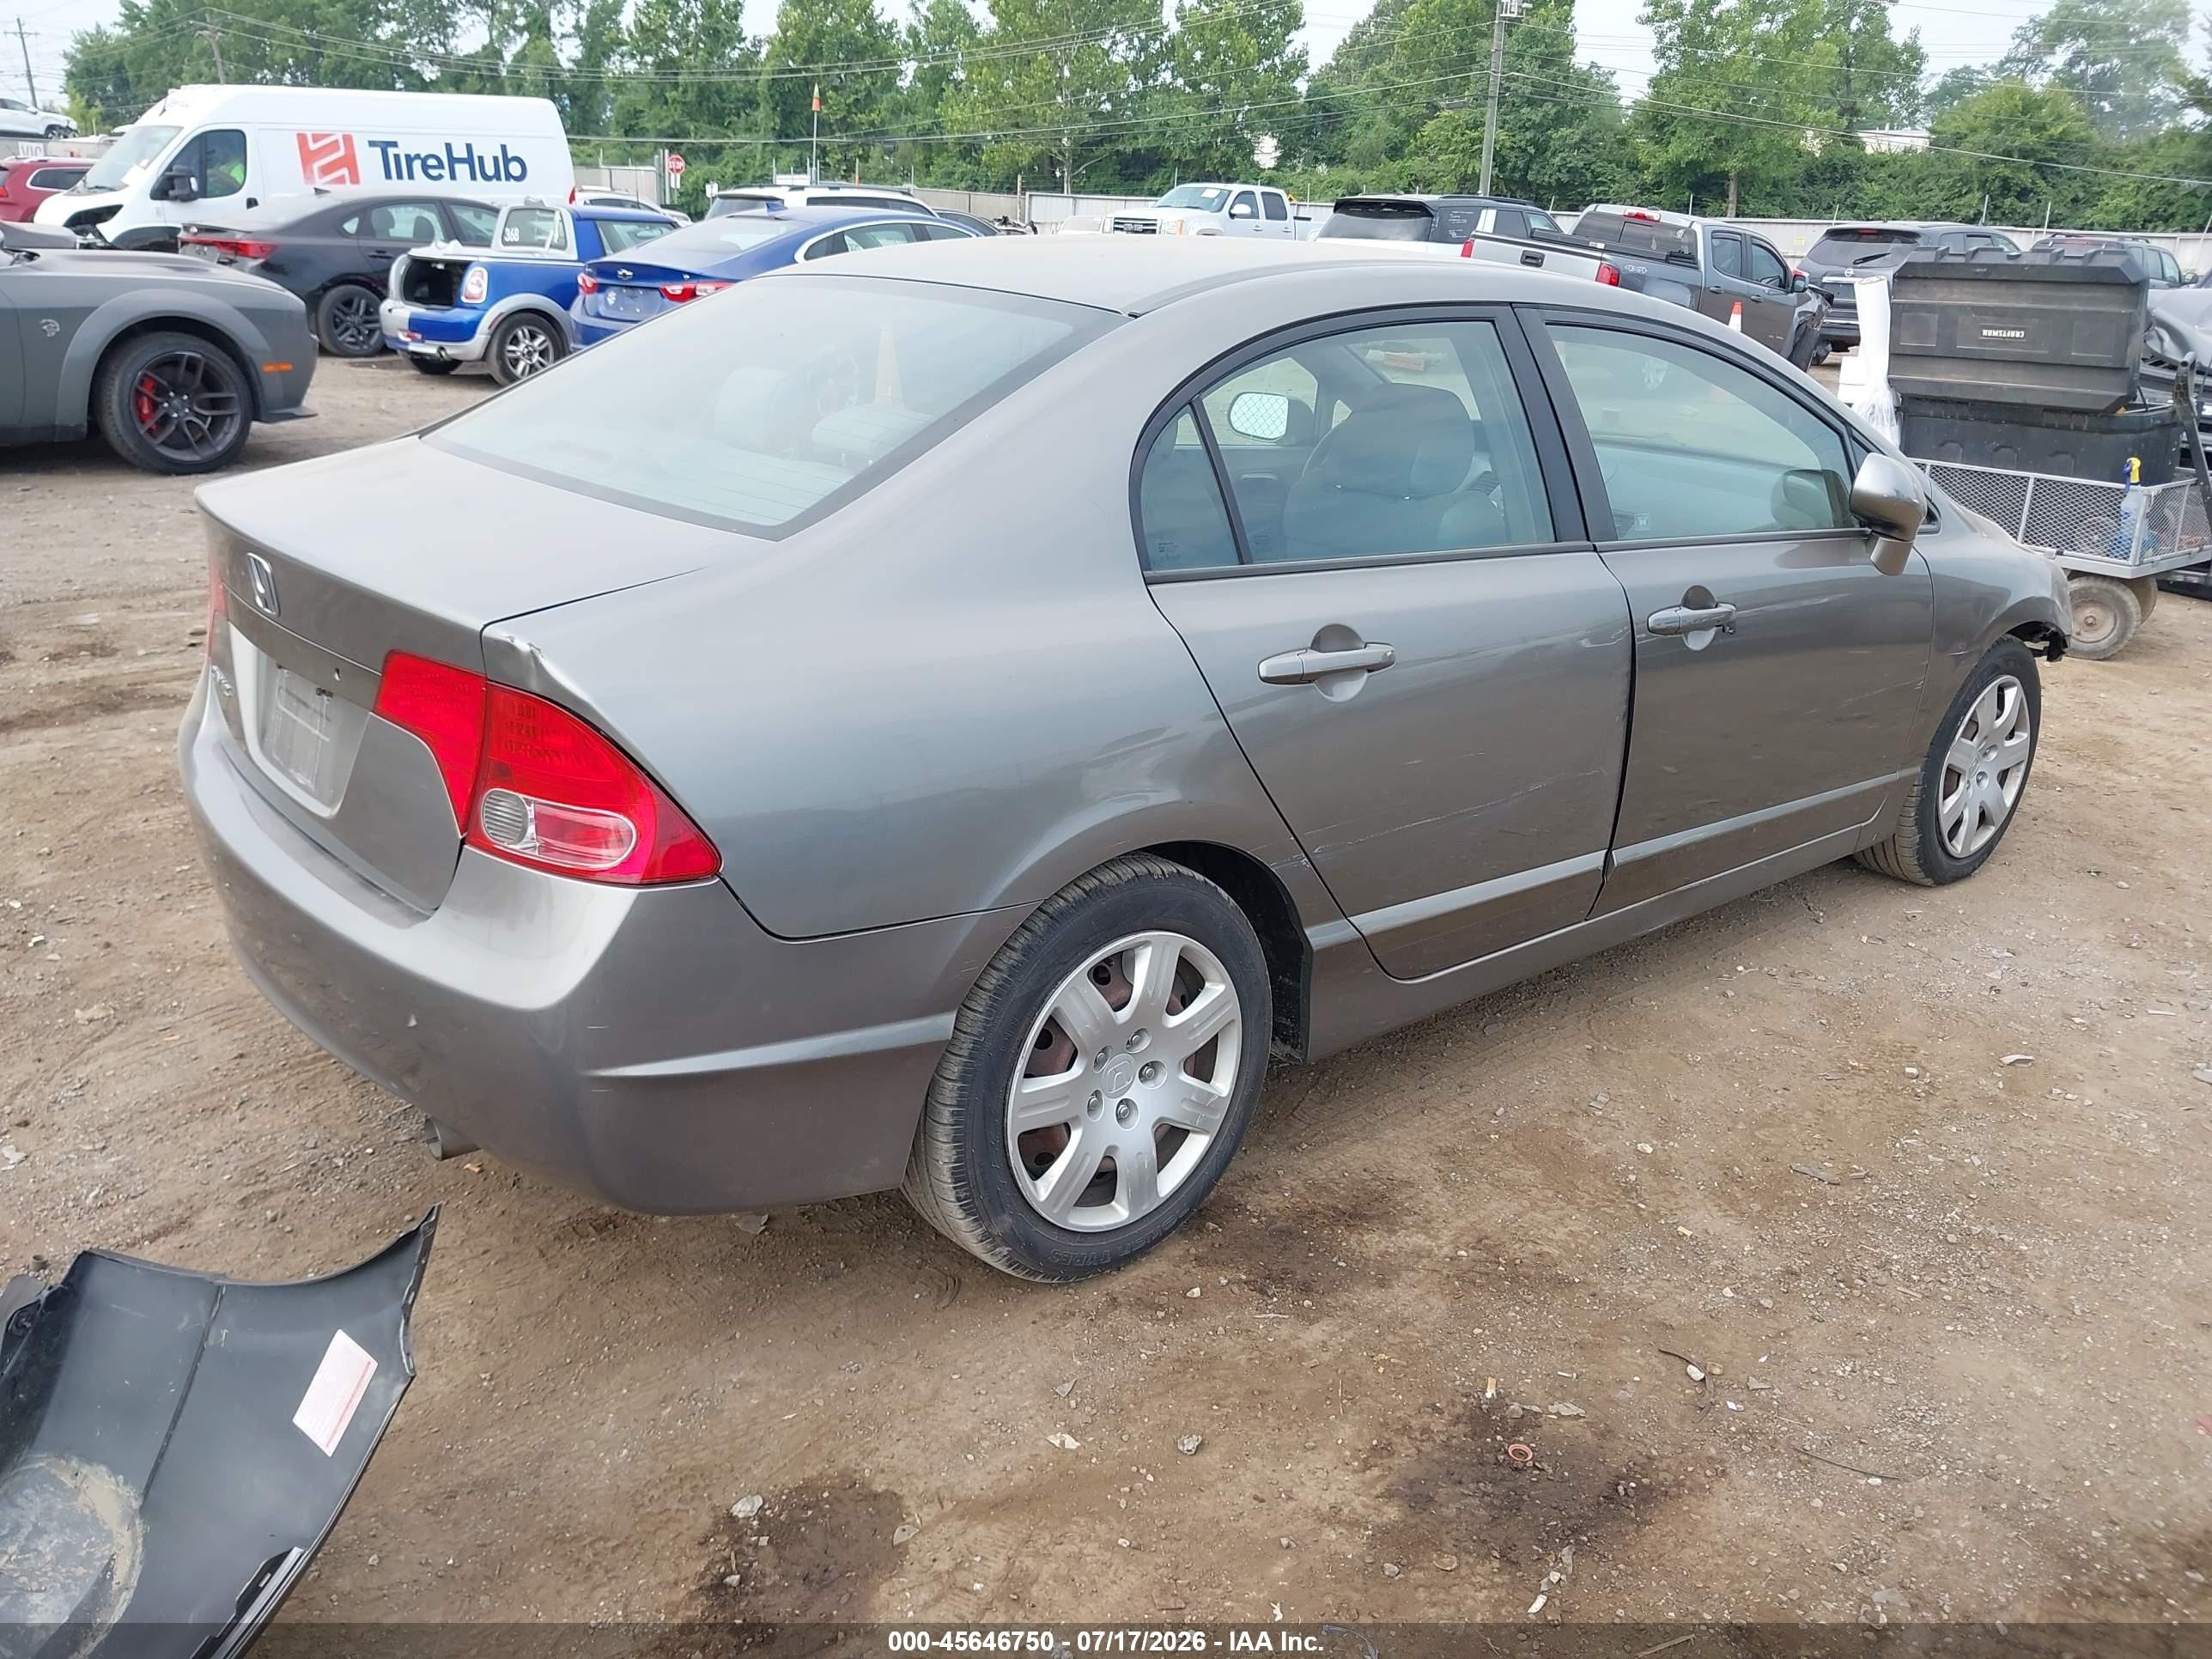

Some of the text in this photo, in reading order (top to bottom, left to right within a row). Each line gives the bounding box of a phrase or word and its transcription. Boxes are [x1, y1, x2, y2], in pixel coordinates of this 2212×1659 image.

[368, 140, 528, 183] TireHub
[503, 227, 520, 242] 368
[1981, 329, 2026, 338] CRAFTSMAN
